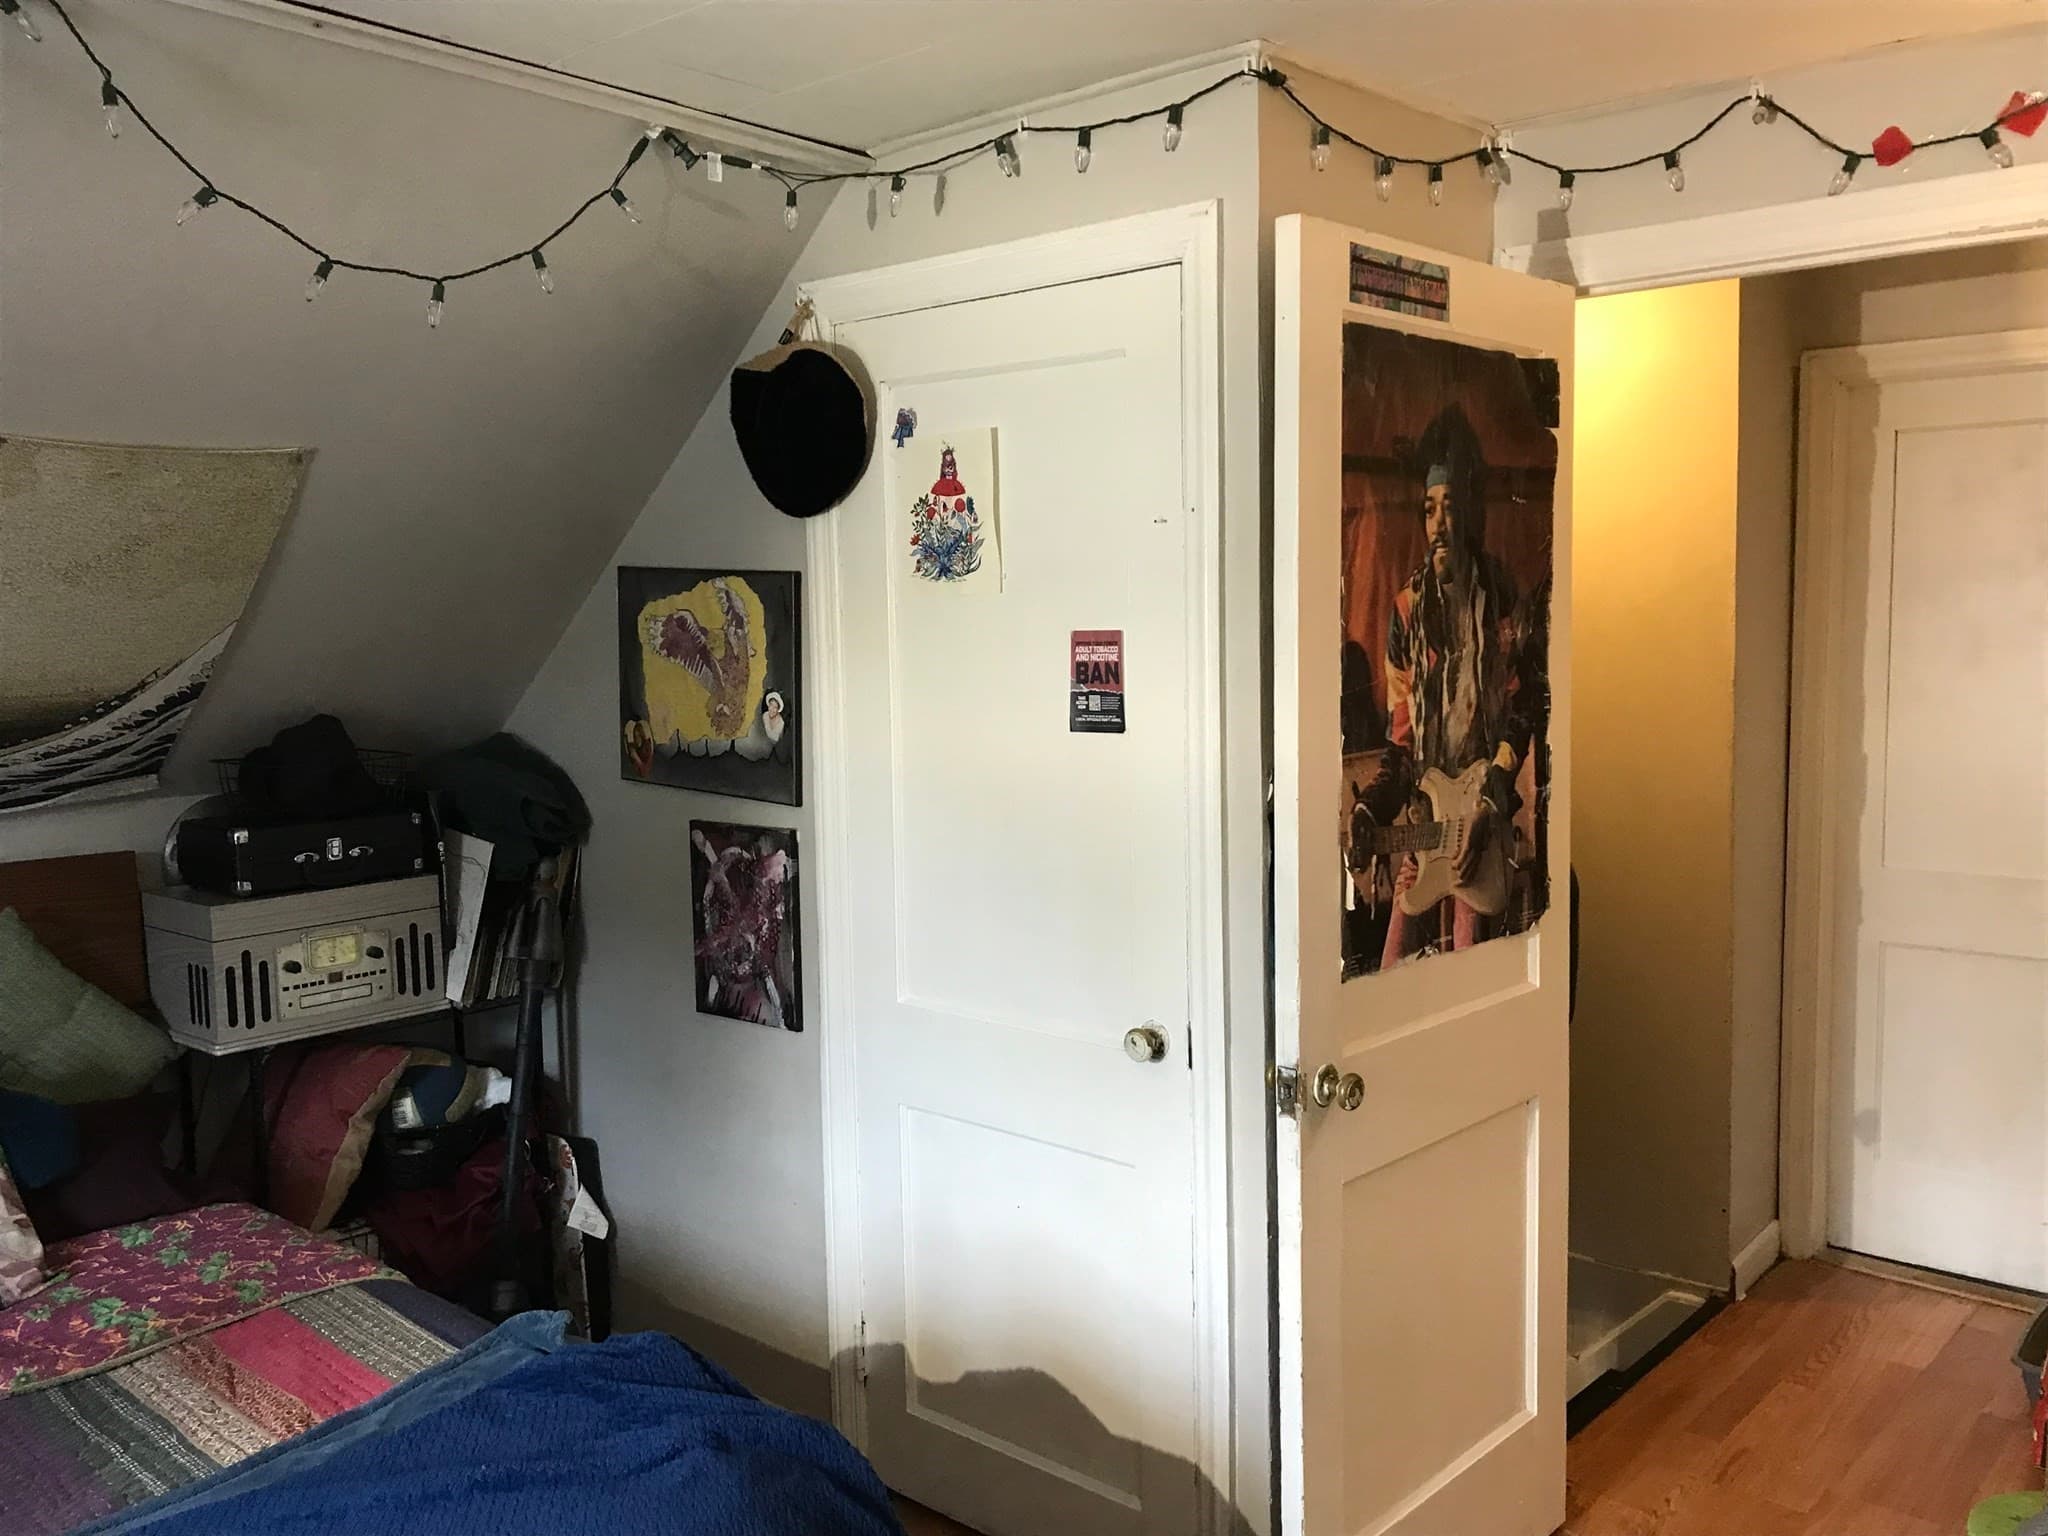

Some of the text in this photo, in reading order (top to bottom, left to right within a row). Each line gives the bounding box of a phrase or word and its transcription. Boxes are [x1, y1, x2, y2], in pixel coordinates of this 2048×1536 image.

[1075, 653, 1119, 661] AND NICOTINE
[1075, 661, 1119, 684] BAN
